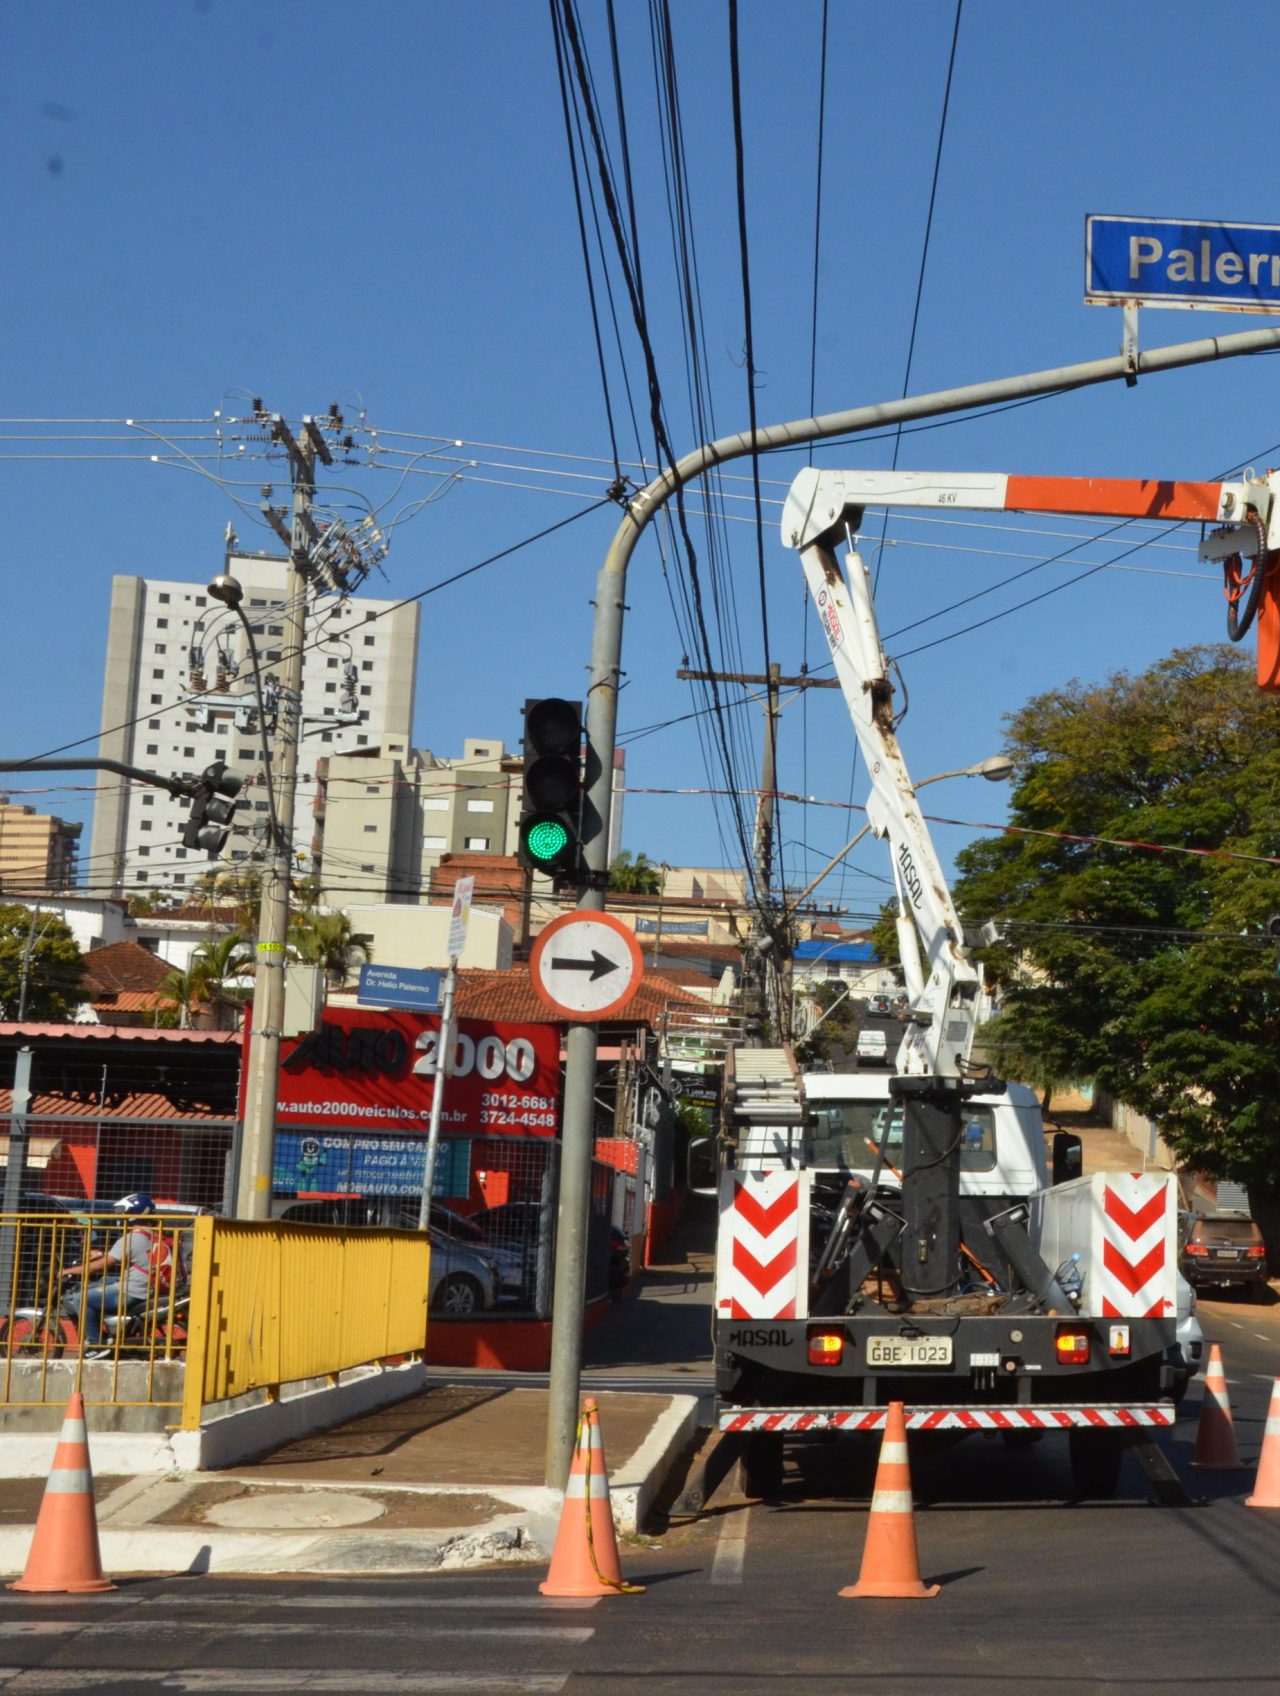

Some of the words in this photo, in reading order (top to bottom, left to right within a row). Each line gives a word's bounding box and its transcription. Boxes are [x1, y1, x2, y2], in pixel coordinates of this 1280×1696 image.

[899, 842, 923, 910] MASAL
[367, 969, 397, 980] Avenida
[399, 983, 429, 993] Palermo
[280, 1024, 407, 1074] AUTO
[412, 1030, 535, 1082] 2000
[481, 1093, 555, 1110] 3012-6681
[480, 1110, 554, 1127] 3724-4548
[381, 1140, 406, 1151] SEU
[364, 1155, 397, 1166] PAGO
[729, 1329, 794, 1347] MASAL
